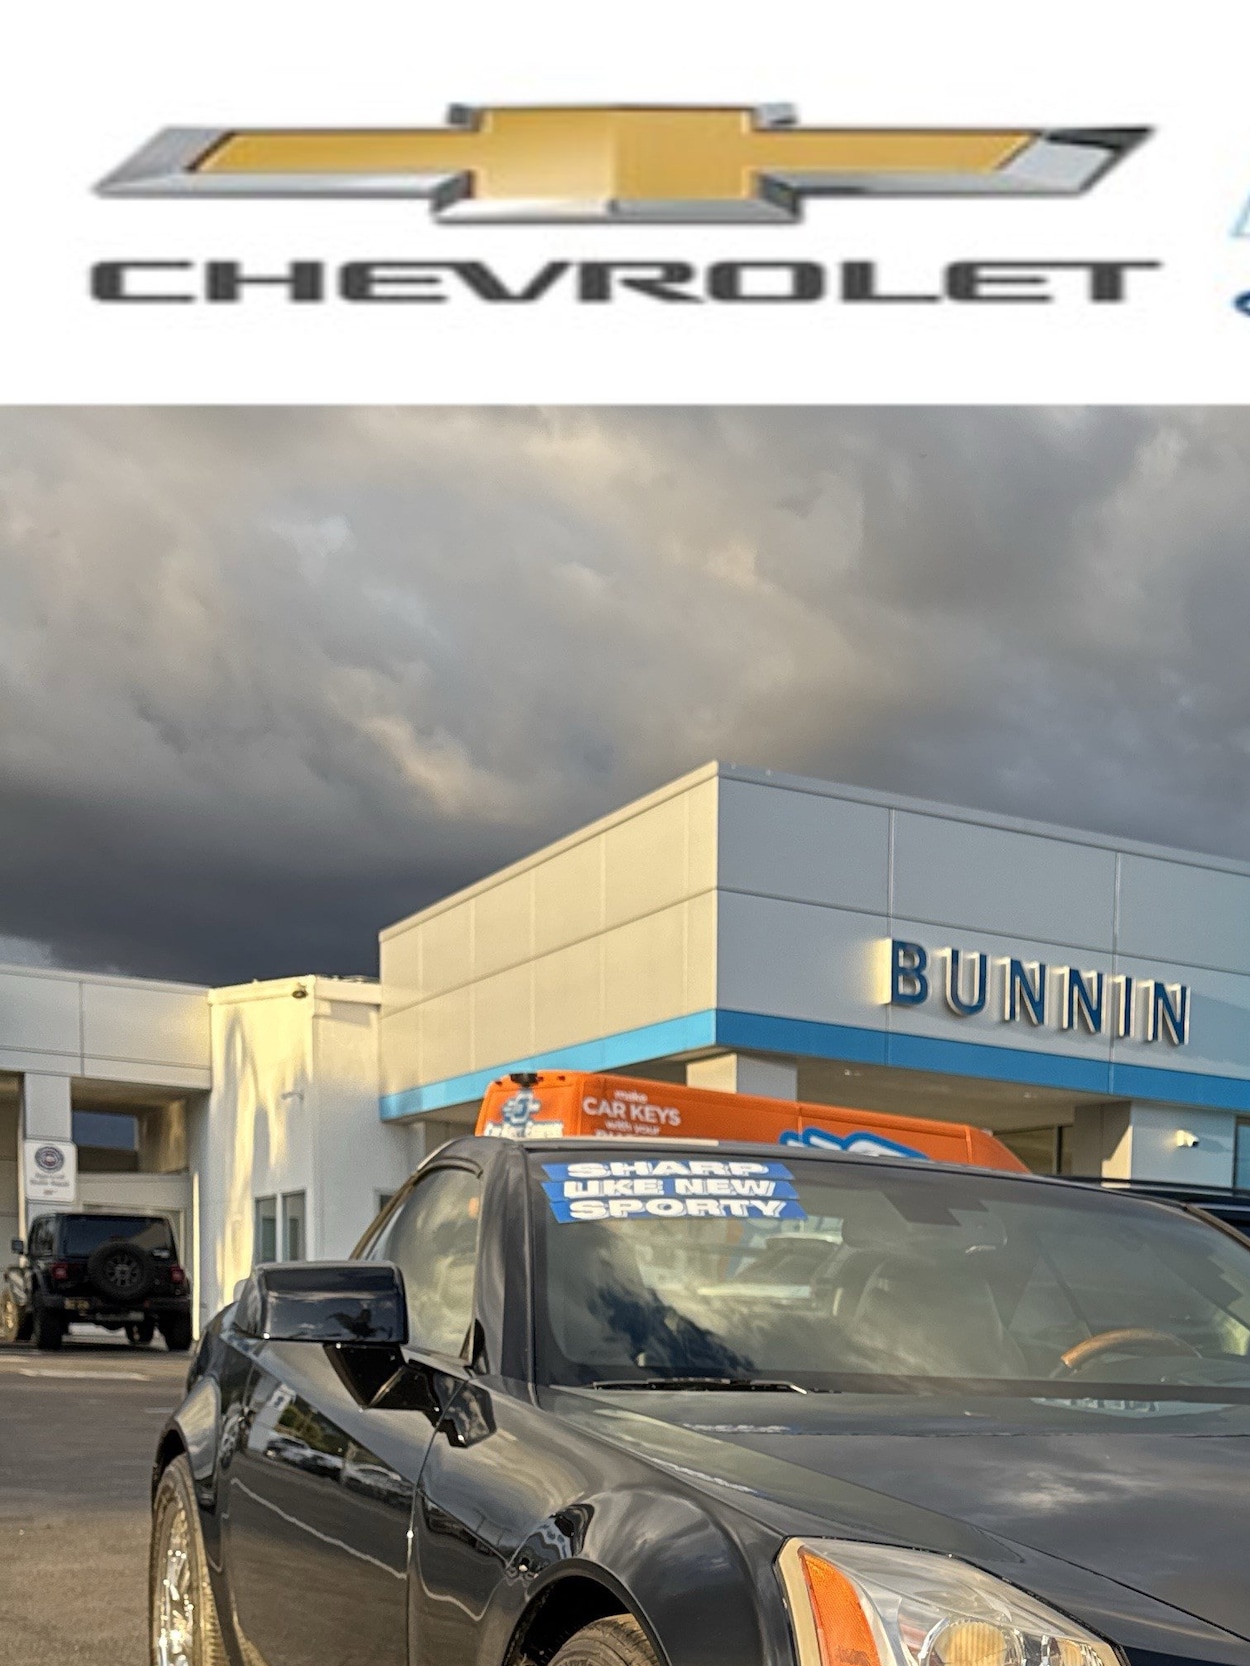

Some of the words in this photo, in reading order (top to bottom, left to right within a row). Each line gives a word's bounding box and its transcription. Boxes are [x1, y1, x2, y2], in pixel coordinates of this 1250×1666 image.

[889, 938, 1191, 1045] BUNNIN
[582, 1096, 626, 1119] CAR
[630, 1104, 681, 1126] KEYS
[568, 1161, 769, 1178] SHARP
[675, 1179, 776, 1197] NEW
[569, 1198, 786, 1219] SPORTY
